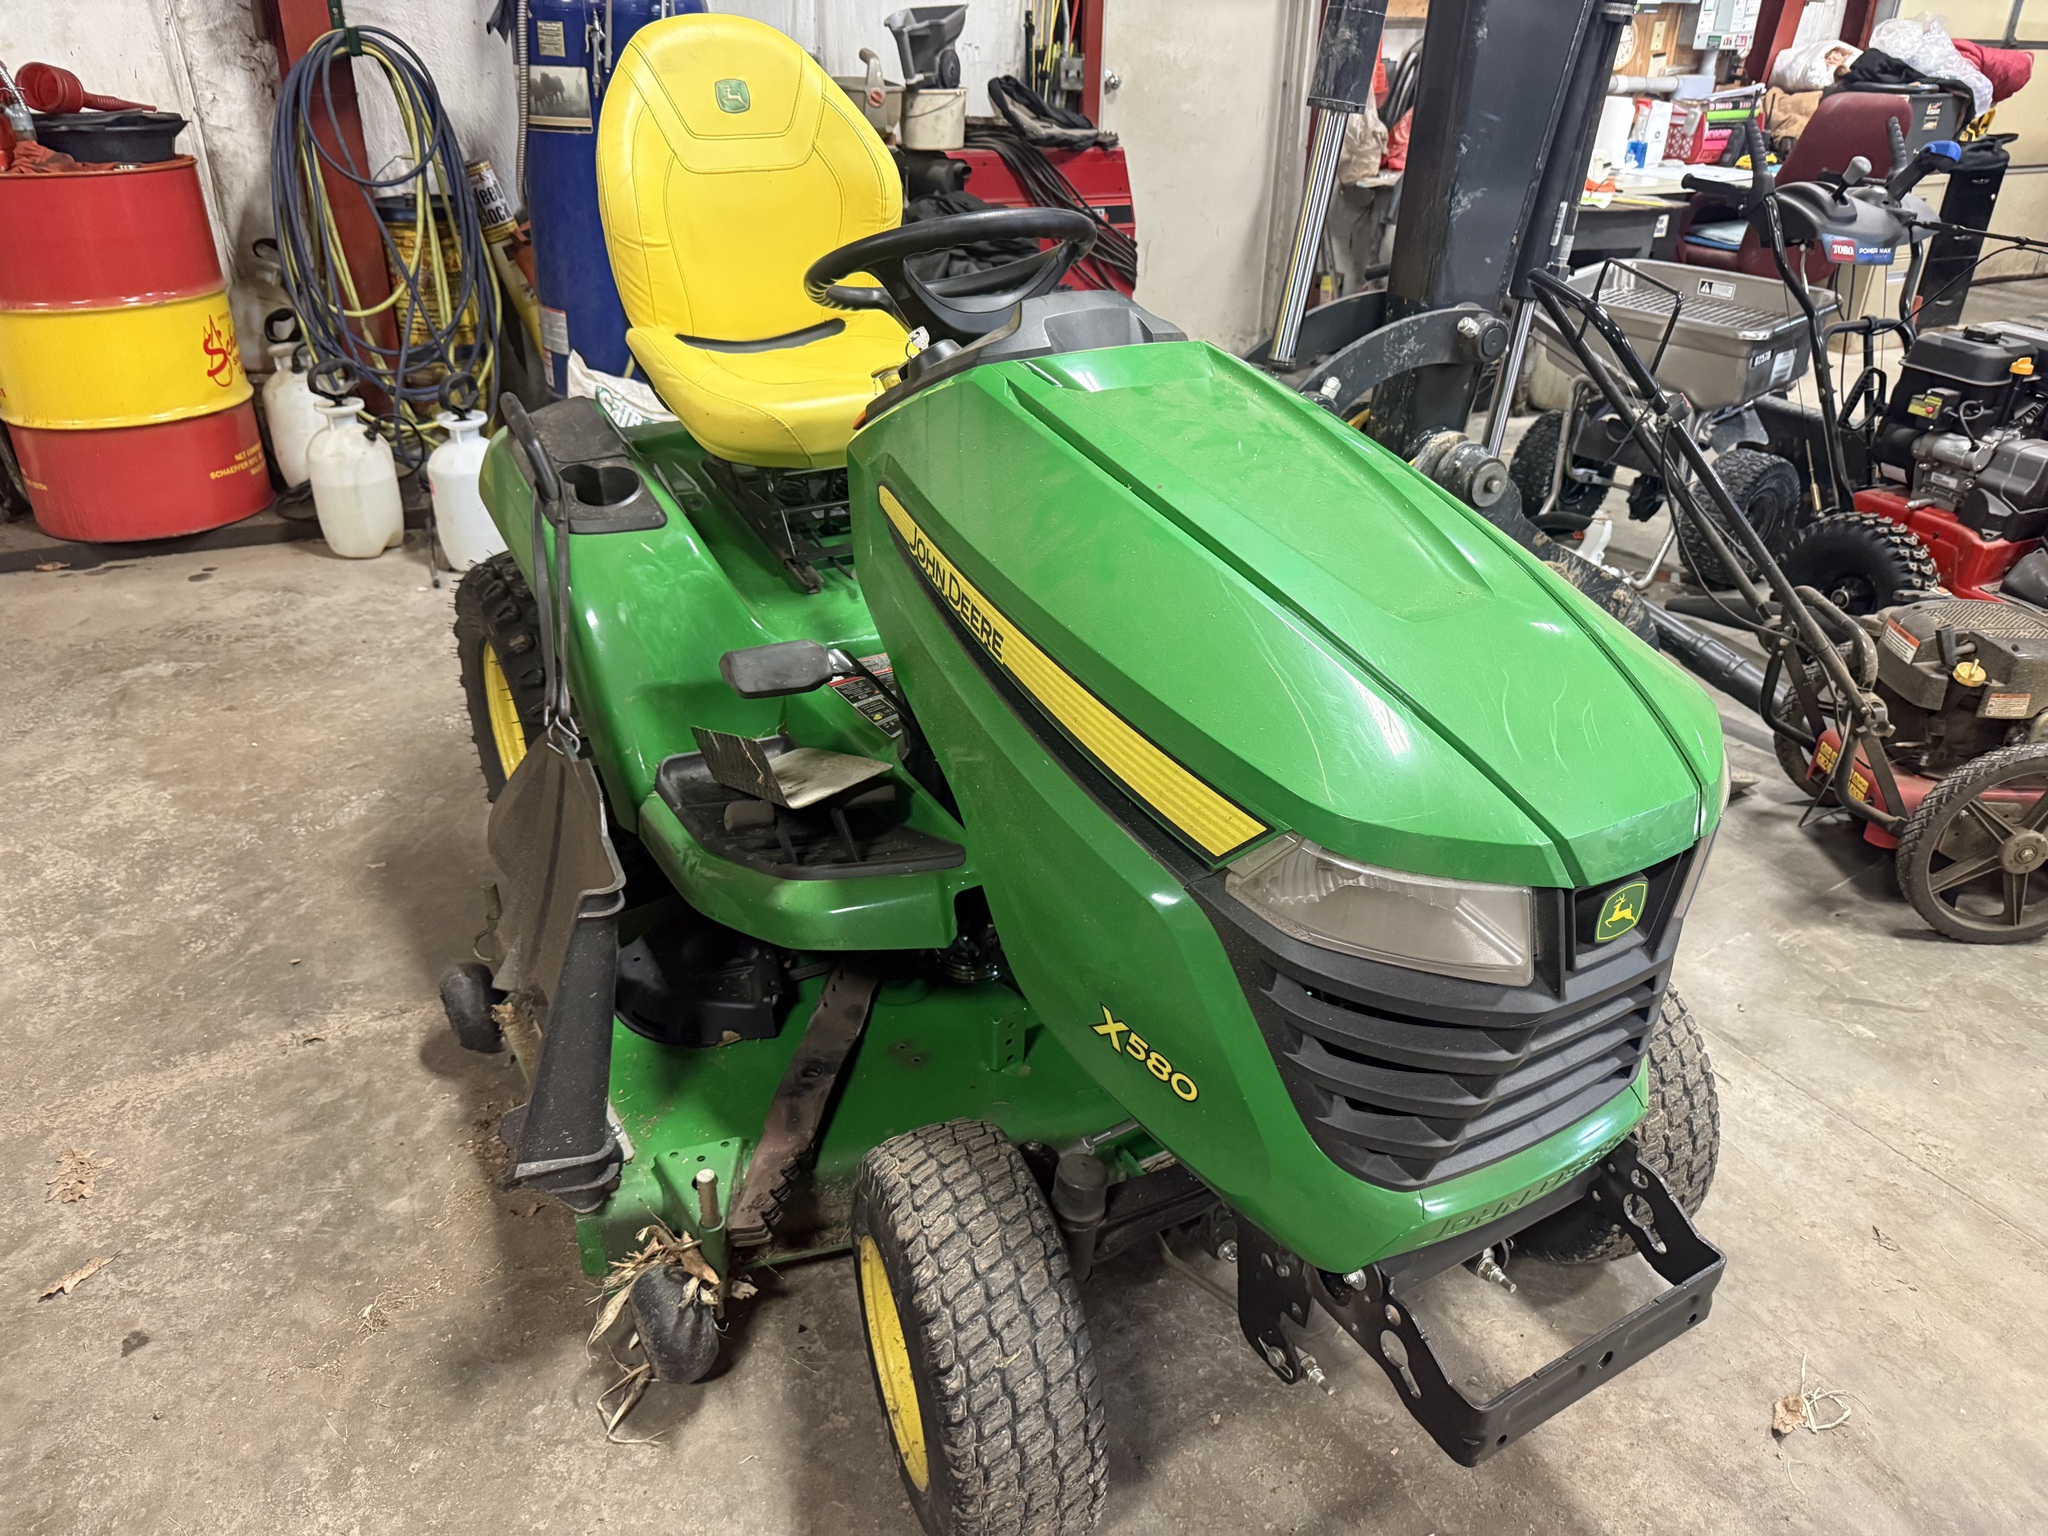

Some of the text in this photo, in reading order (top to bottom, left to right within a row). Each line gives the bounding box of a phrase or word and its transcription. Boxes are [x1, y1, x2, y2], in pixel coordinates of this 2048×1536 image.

[1832, 244, 1855, 256] TORO
[1858, 247, 1878, 255] POWER
[209, 460, 249, 480] SCHAEFFER
[908, 526, 1004, 660] JOHN DEERE
[1089, 1001, 1200, 1103] X580
